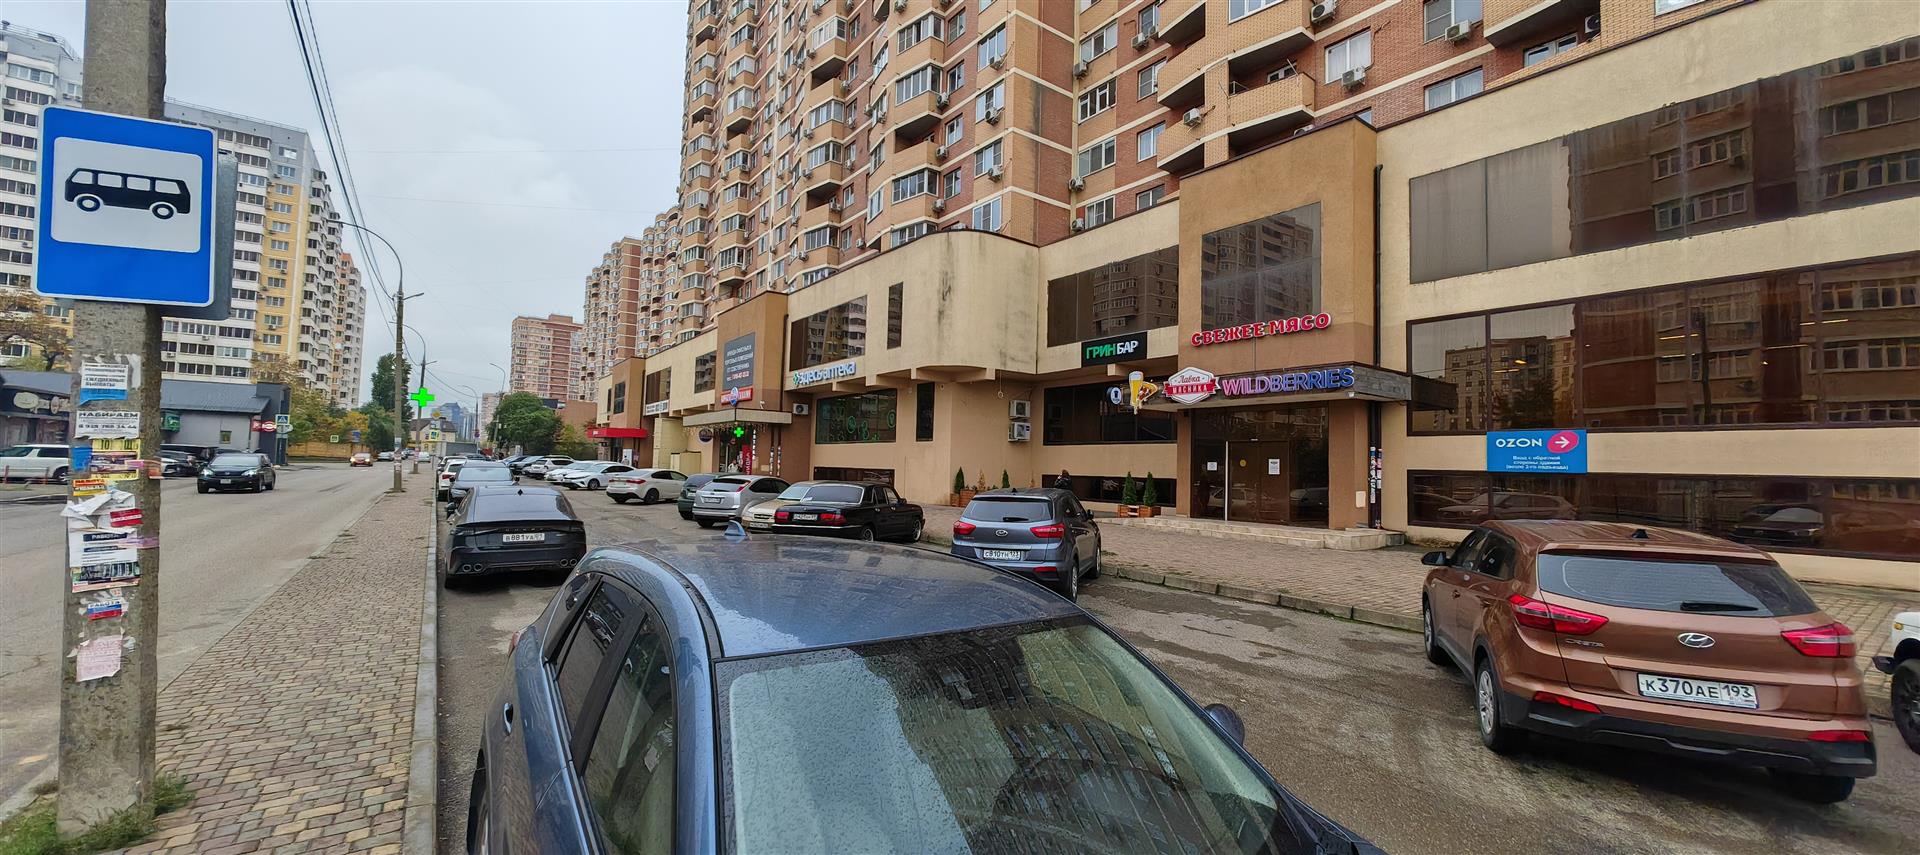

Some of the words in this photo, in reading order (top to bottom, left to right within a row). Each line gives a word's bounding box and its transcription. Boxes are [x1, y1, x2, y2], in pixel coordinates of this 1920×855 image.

[1191, 322, 1265, 347] СВЕЖЕЕ
[1268, 312, 1331, 335] МЯСО
[1086, 343, 1116, 360] ГРИН
[1116, 340, 1139, 355] БАР
[1178, 375, 1201, 384] Лавка
[1221, 367, 1355, 396] WILDBERRIES
[1172, 384, 1208, 395] МЯСНИКА
[1495, 437, 1543, 448] OZON
